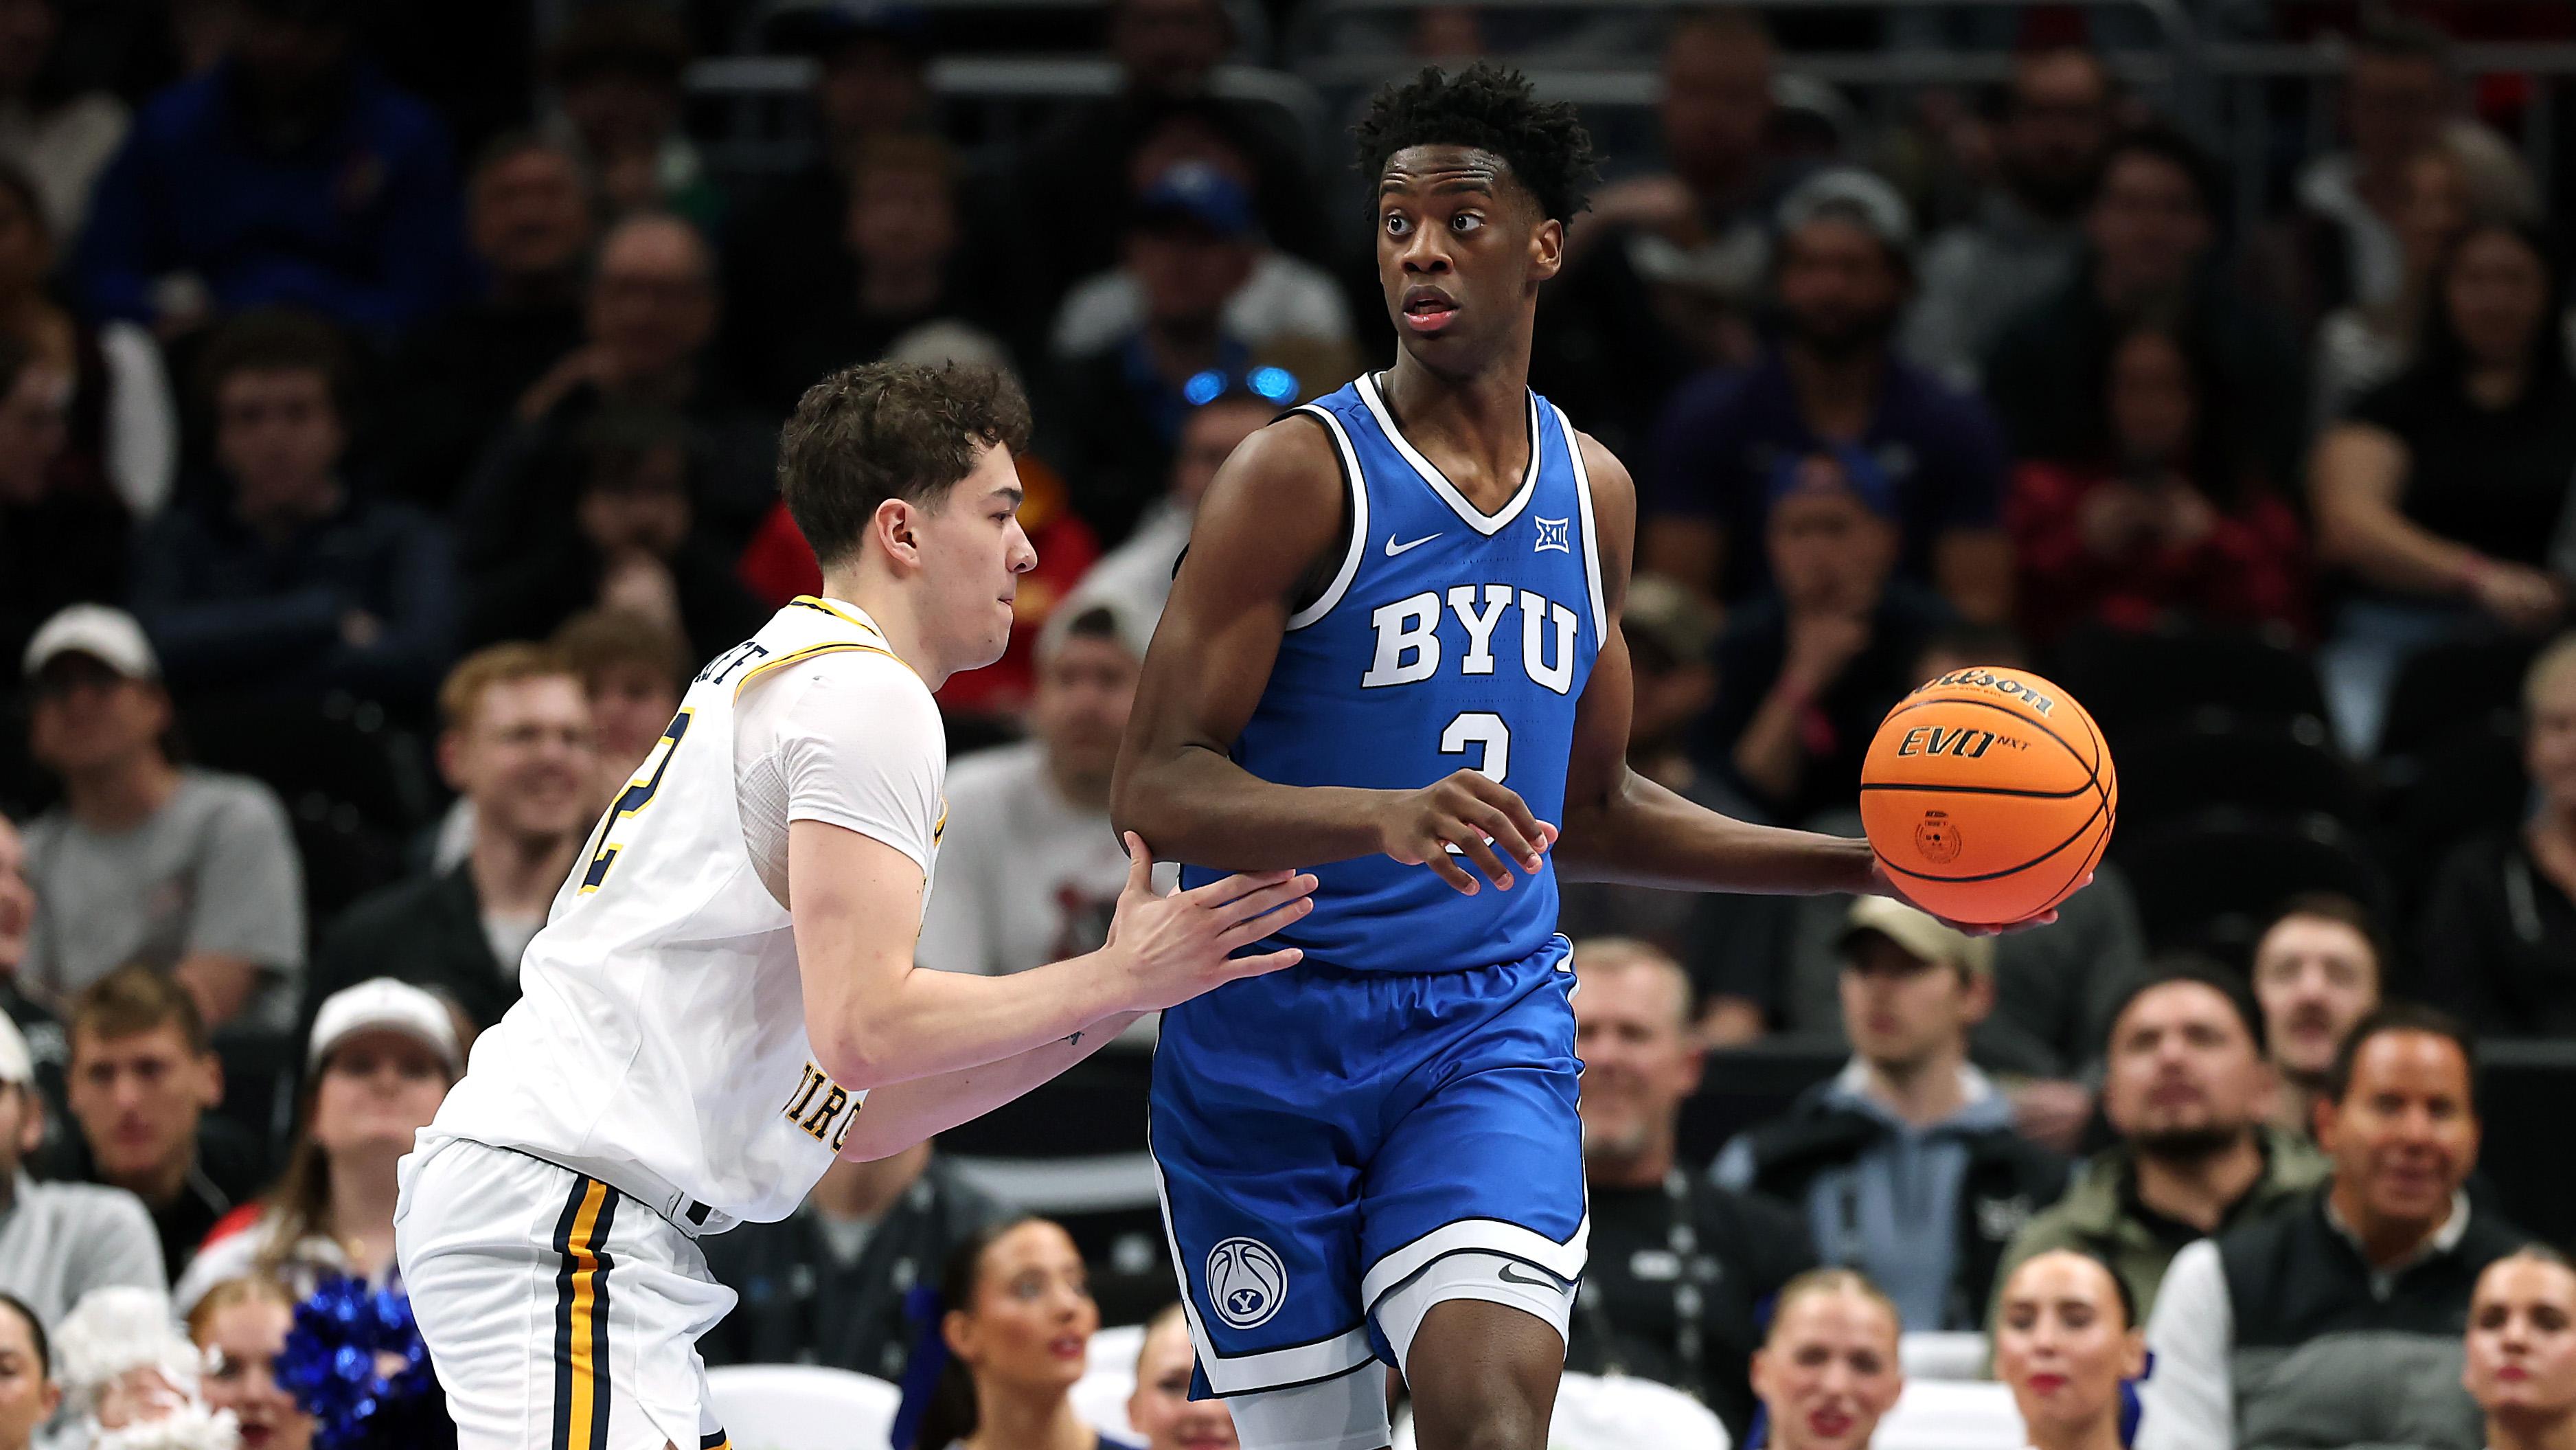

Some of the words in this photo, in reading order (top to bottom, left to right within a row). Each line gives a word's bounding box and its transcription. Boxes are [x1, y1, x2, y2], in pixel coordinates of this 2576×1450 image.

[1361, 583, 1577, 696] BYU
[1897, 725, 1996, 758] EVO
[1996, 736, 2032, 753] NXT
[1231, 1291, 1256, 1313] Y
